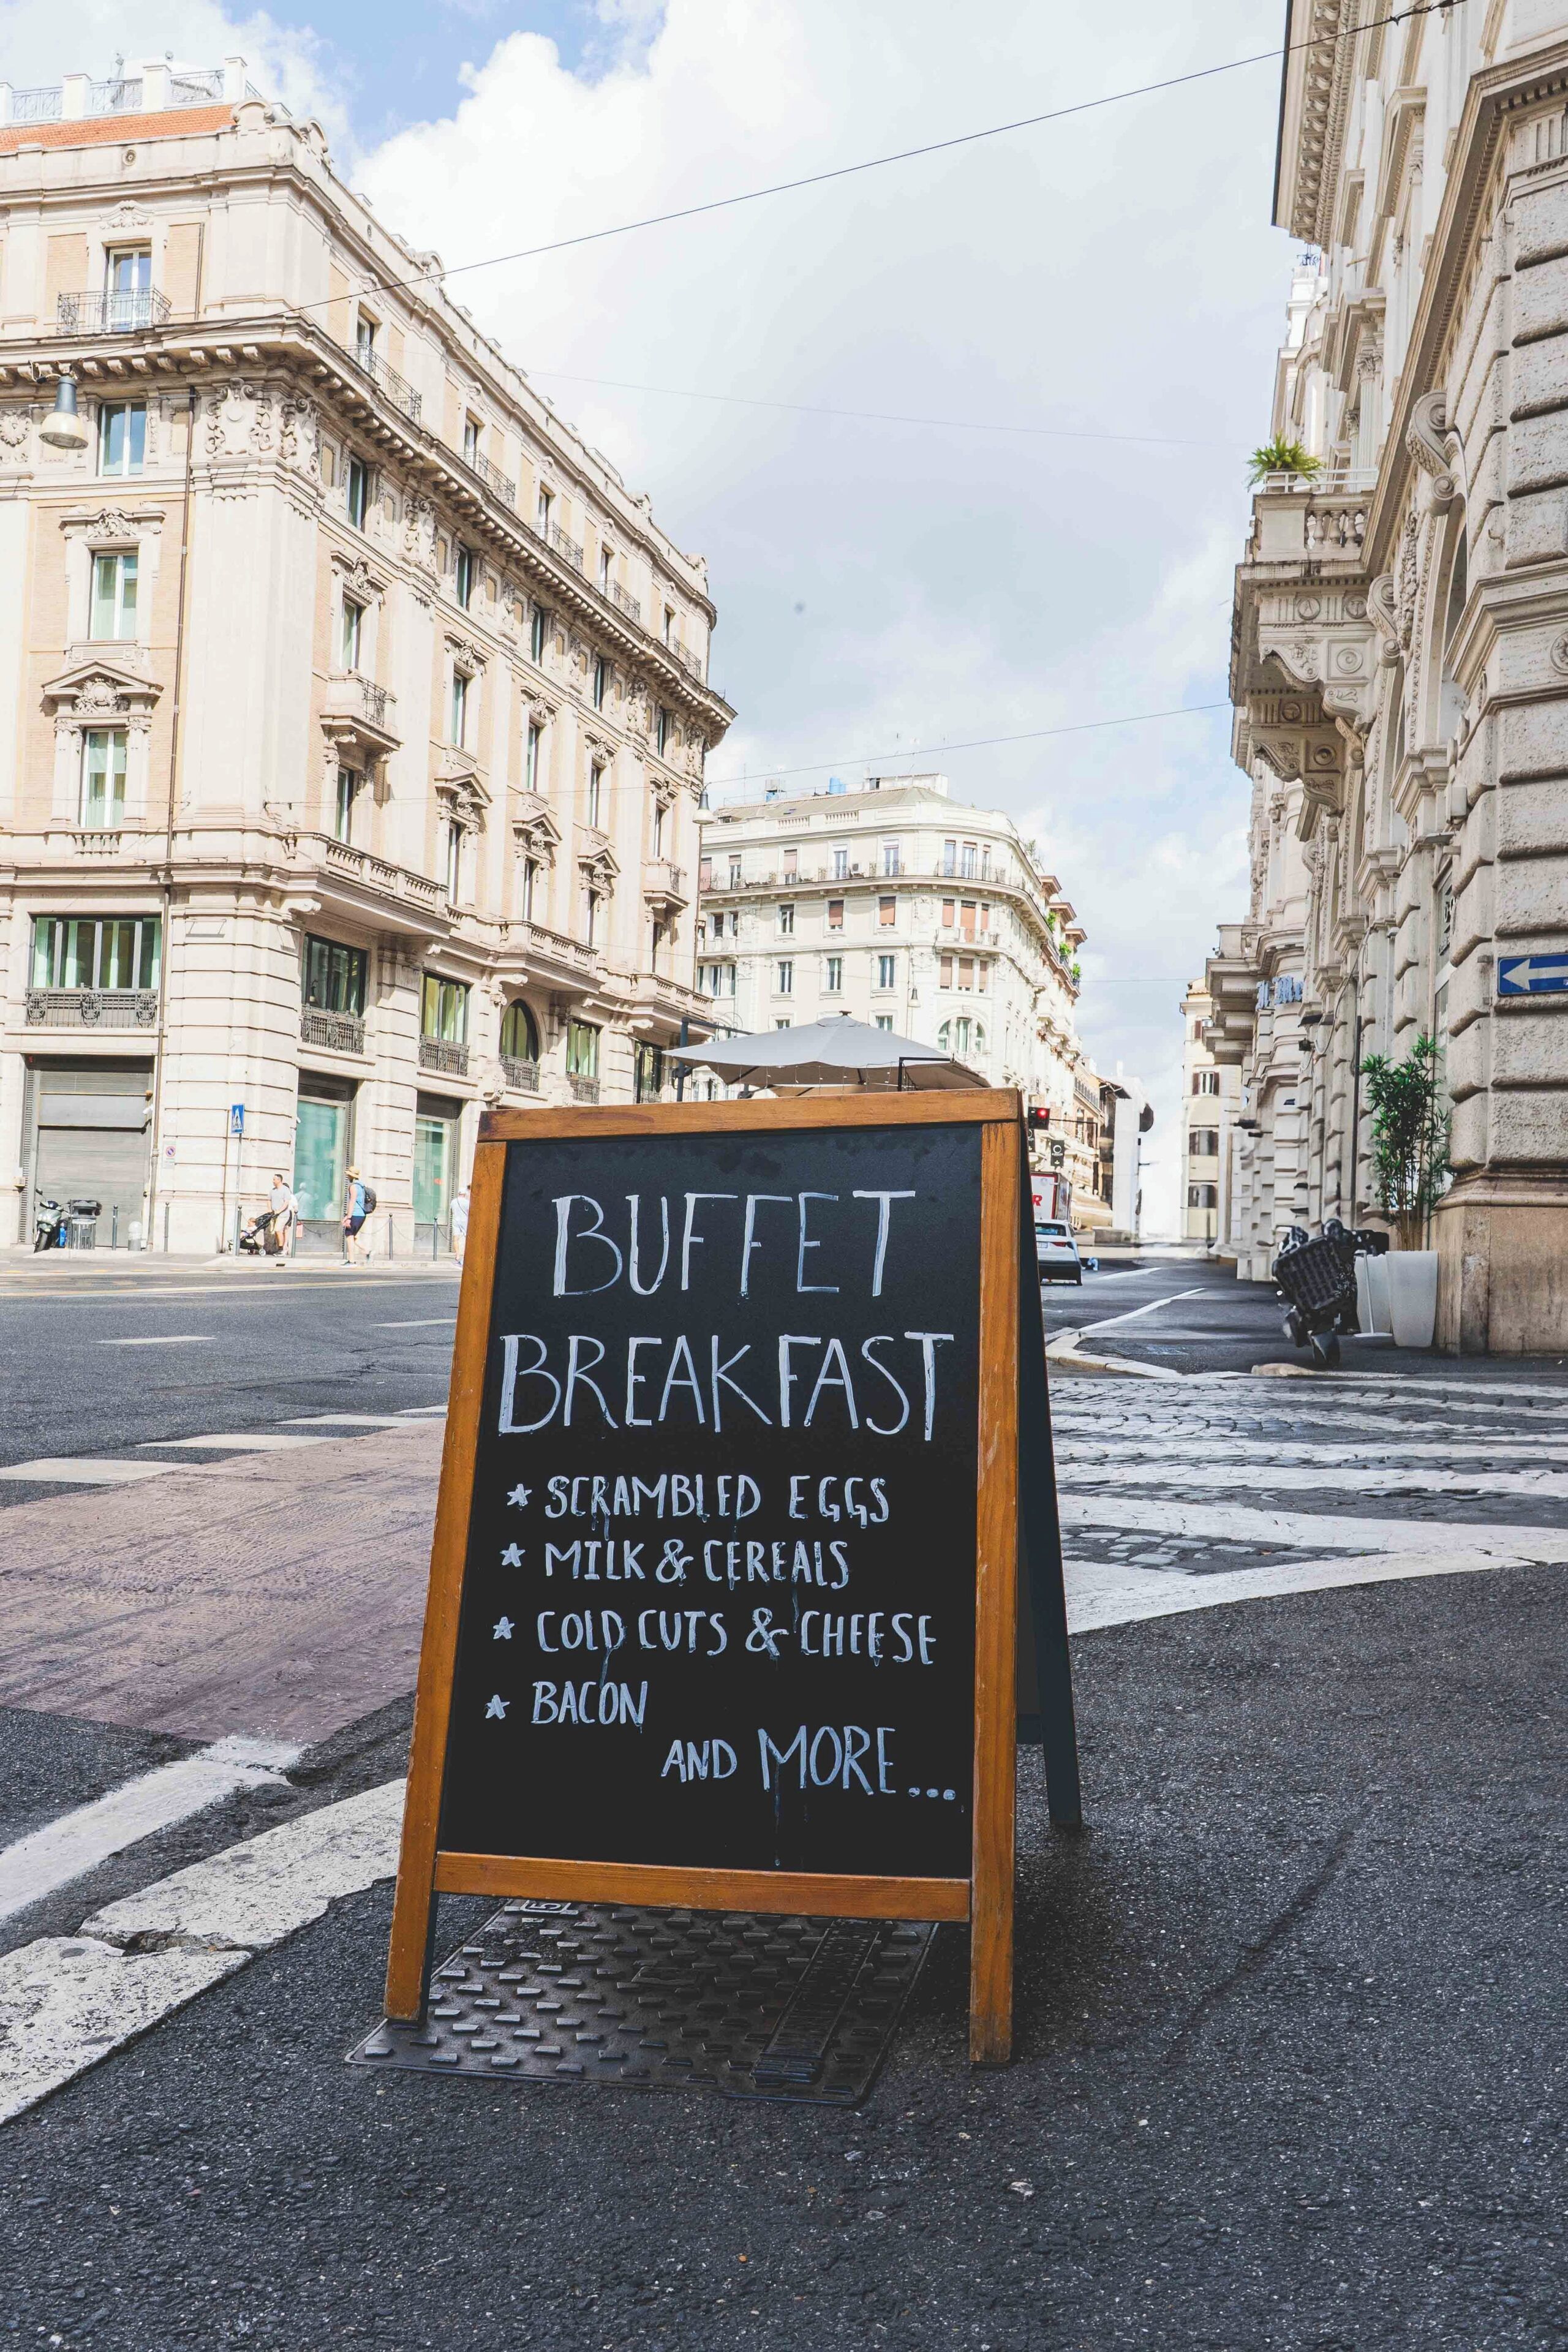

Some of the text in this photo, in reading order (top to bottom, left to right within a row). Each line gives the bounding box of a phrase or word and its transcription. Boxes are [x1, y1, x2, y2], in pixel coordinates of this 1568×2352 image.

[551, 1189, 916, 1298] BUFFET
[498, 1331, 955, 1442] BREAKFAST
[545, 1474, 889, 1529] SCRAMBLED EGGS
[545, 1539, 849, 1590] MILK & CEREALS
[537, 1607, 937, 1666] COLD CUTS & CHEESE
[530, 1680, 648, 1727] BACON
[660, 1739, 737, 1783] AND
